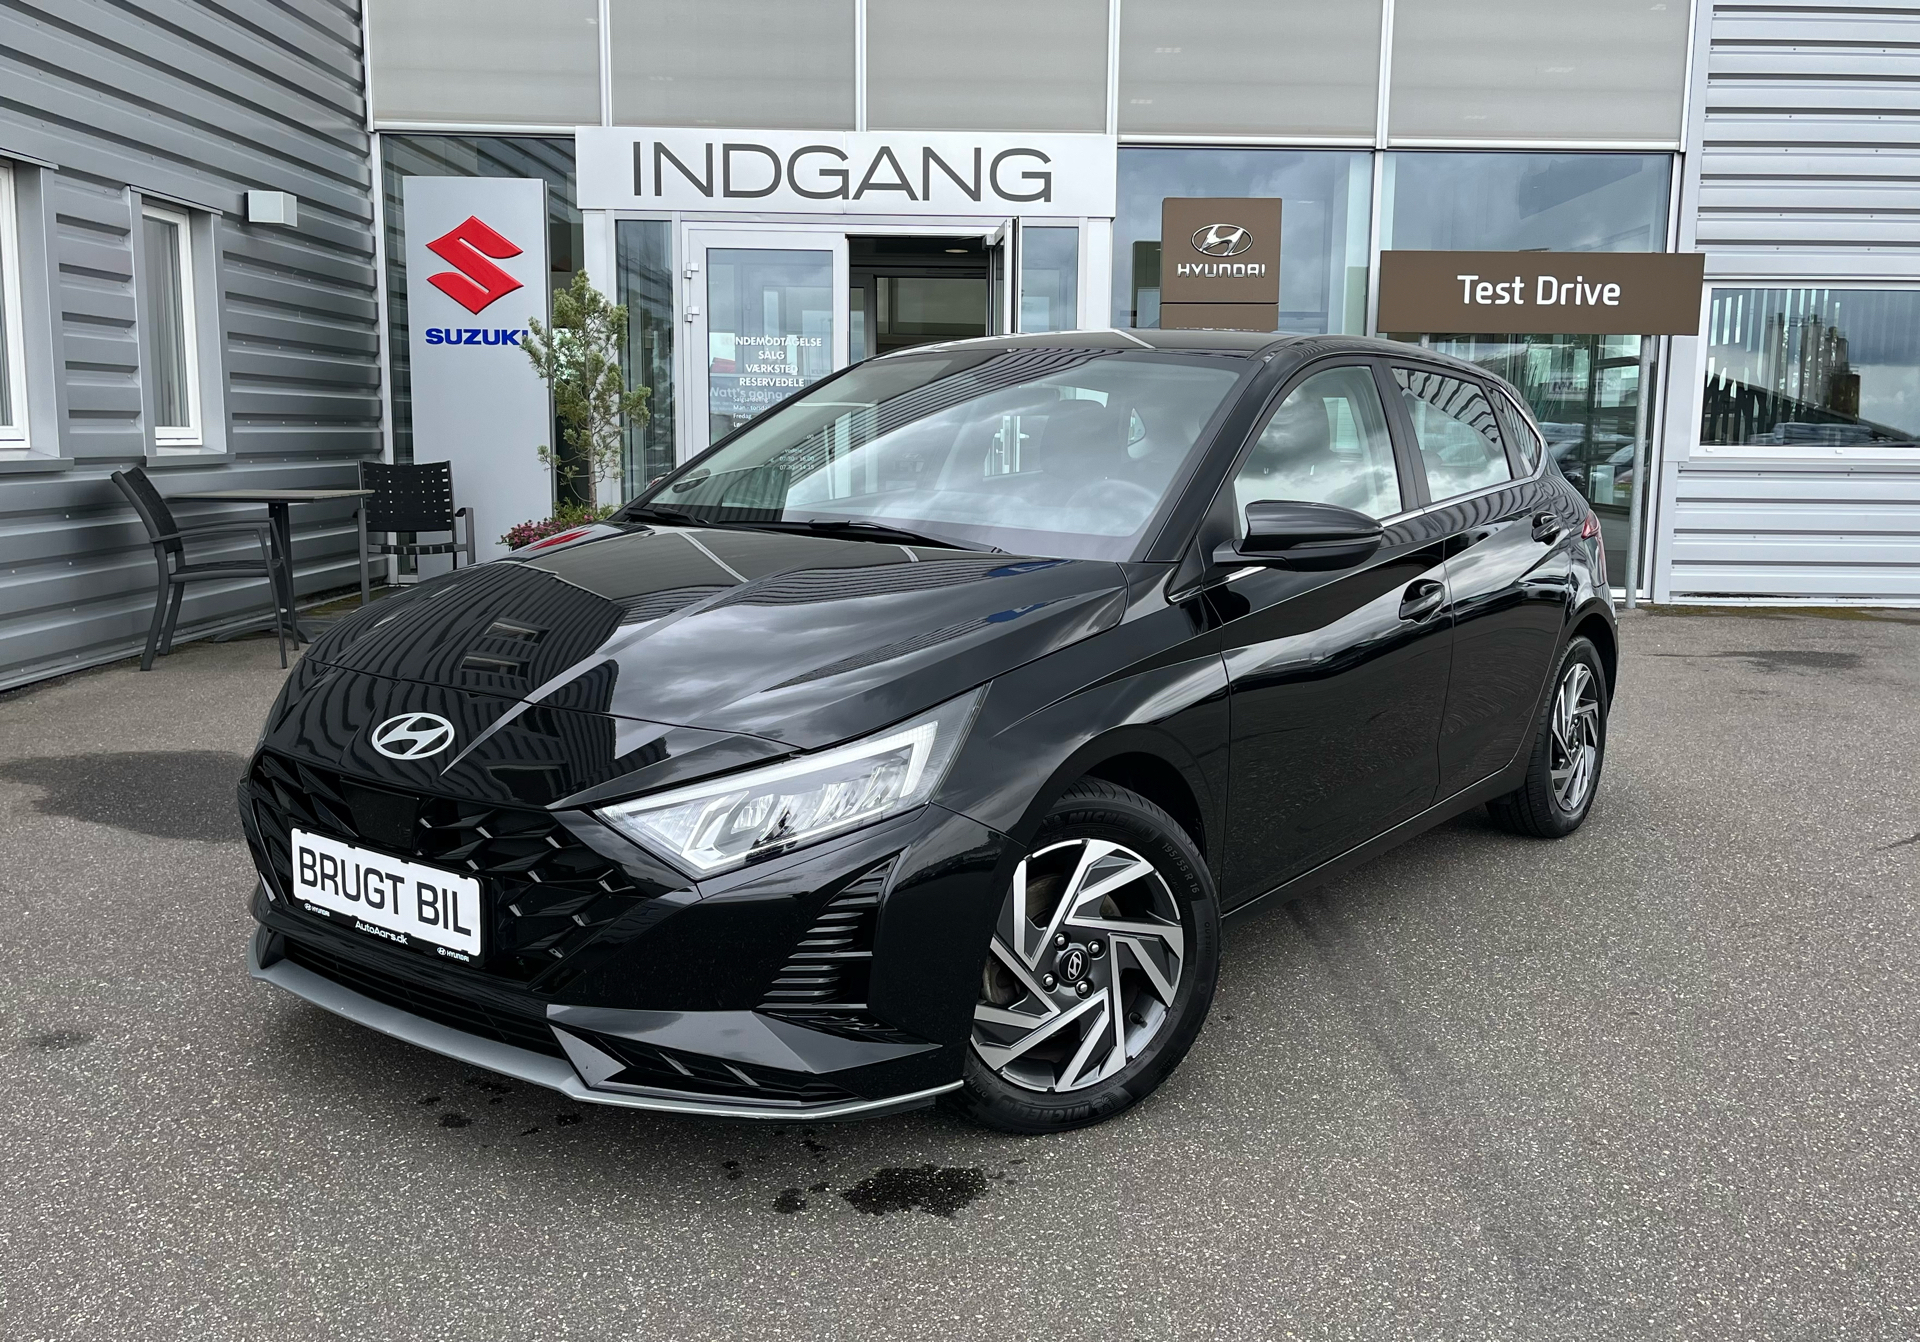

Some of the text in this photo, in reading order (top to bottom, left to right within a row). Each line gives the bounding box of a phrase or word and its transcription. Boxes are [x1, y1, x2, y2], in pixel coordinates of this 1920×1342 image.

[633, 141, 1052, 203] INDGANG
[1177, 263, 1266, 278] HYUNDAI
[1457, 274, 1621, 306] Test Drive
[745, 364, 798, 374] VÆRKSTED
[739, 377, 804, 387] RESERVEDELE
[1161, 842, 1190, 873] 195/55
[1188, 882, 1201, 895] 16
[298, 845, 472, 937] BRUGT BIL
[355, 920, 409, 945] AutoAars.dk
[446, 950, 470, 963] HYUNDAI
